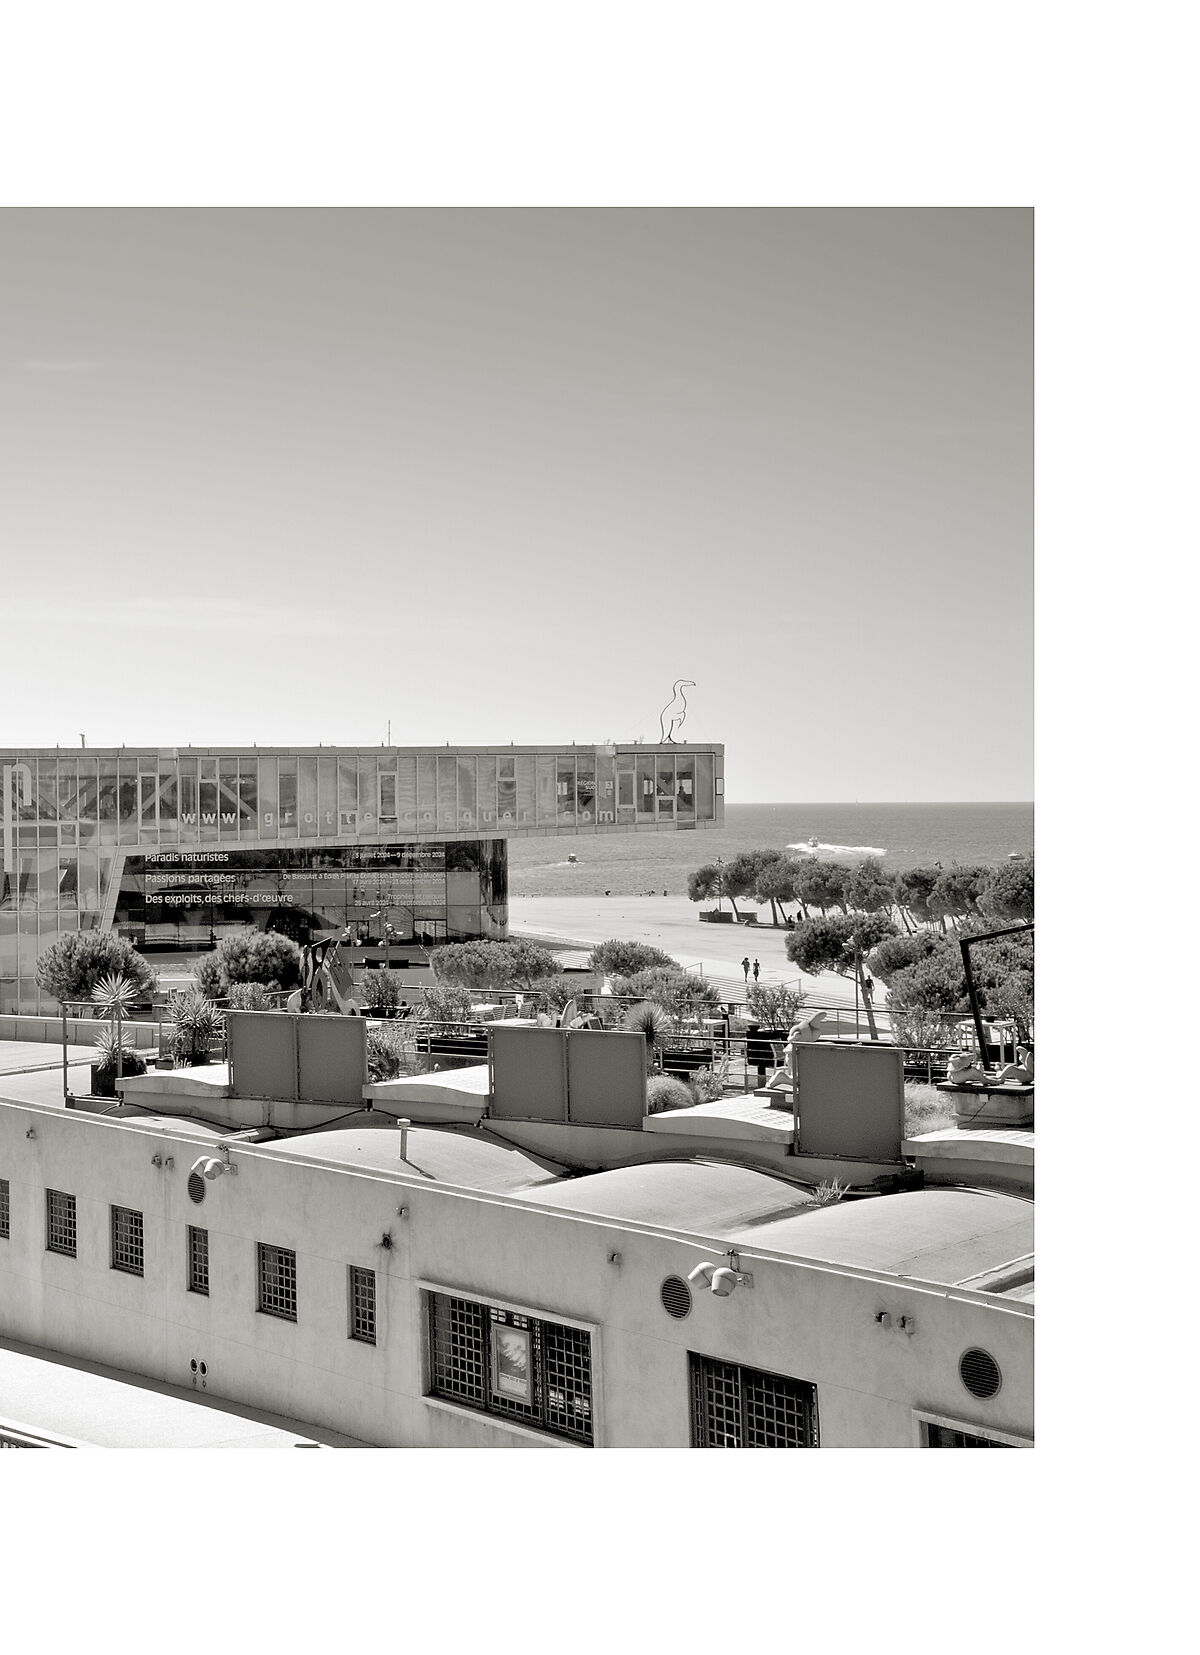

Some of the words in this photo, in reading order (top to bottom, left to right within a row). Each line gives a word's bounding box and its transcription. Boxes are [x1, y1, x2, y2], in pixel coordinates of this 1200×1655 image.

[145, 853, 179, 862] Paradis
[181, 852, 229, 862] naturistes
[145, 874, 186, 883] Passions
[188, 874, 236, 884] partagées
[145, 894, 163, 903] Des
[164, 893, 205, 905] exploits,
[205, 893, 222, 903] des
